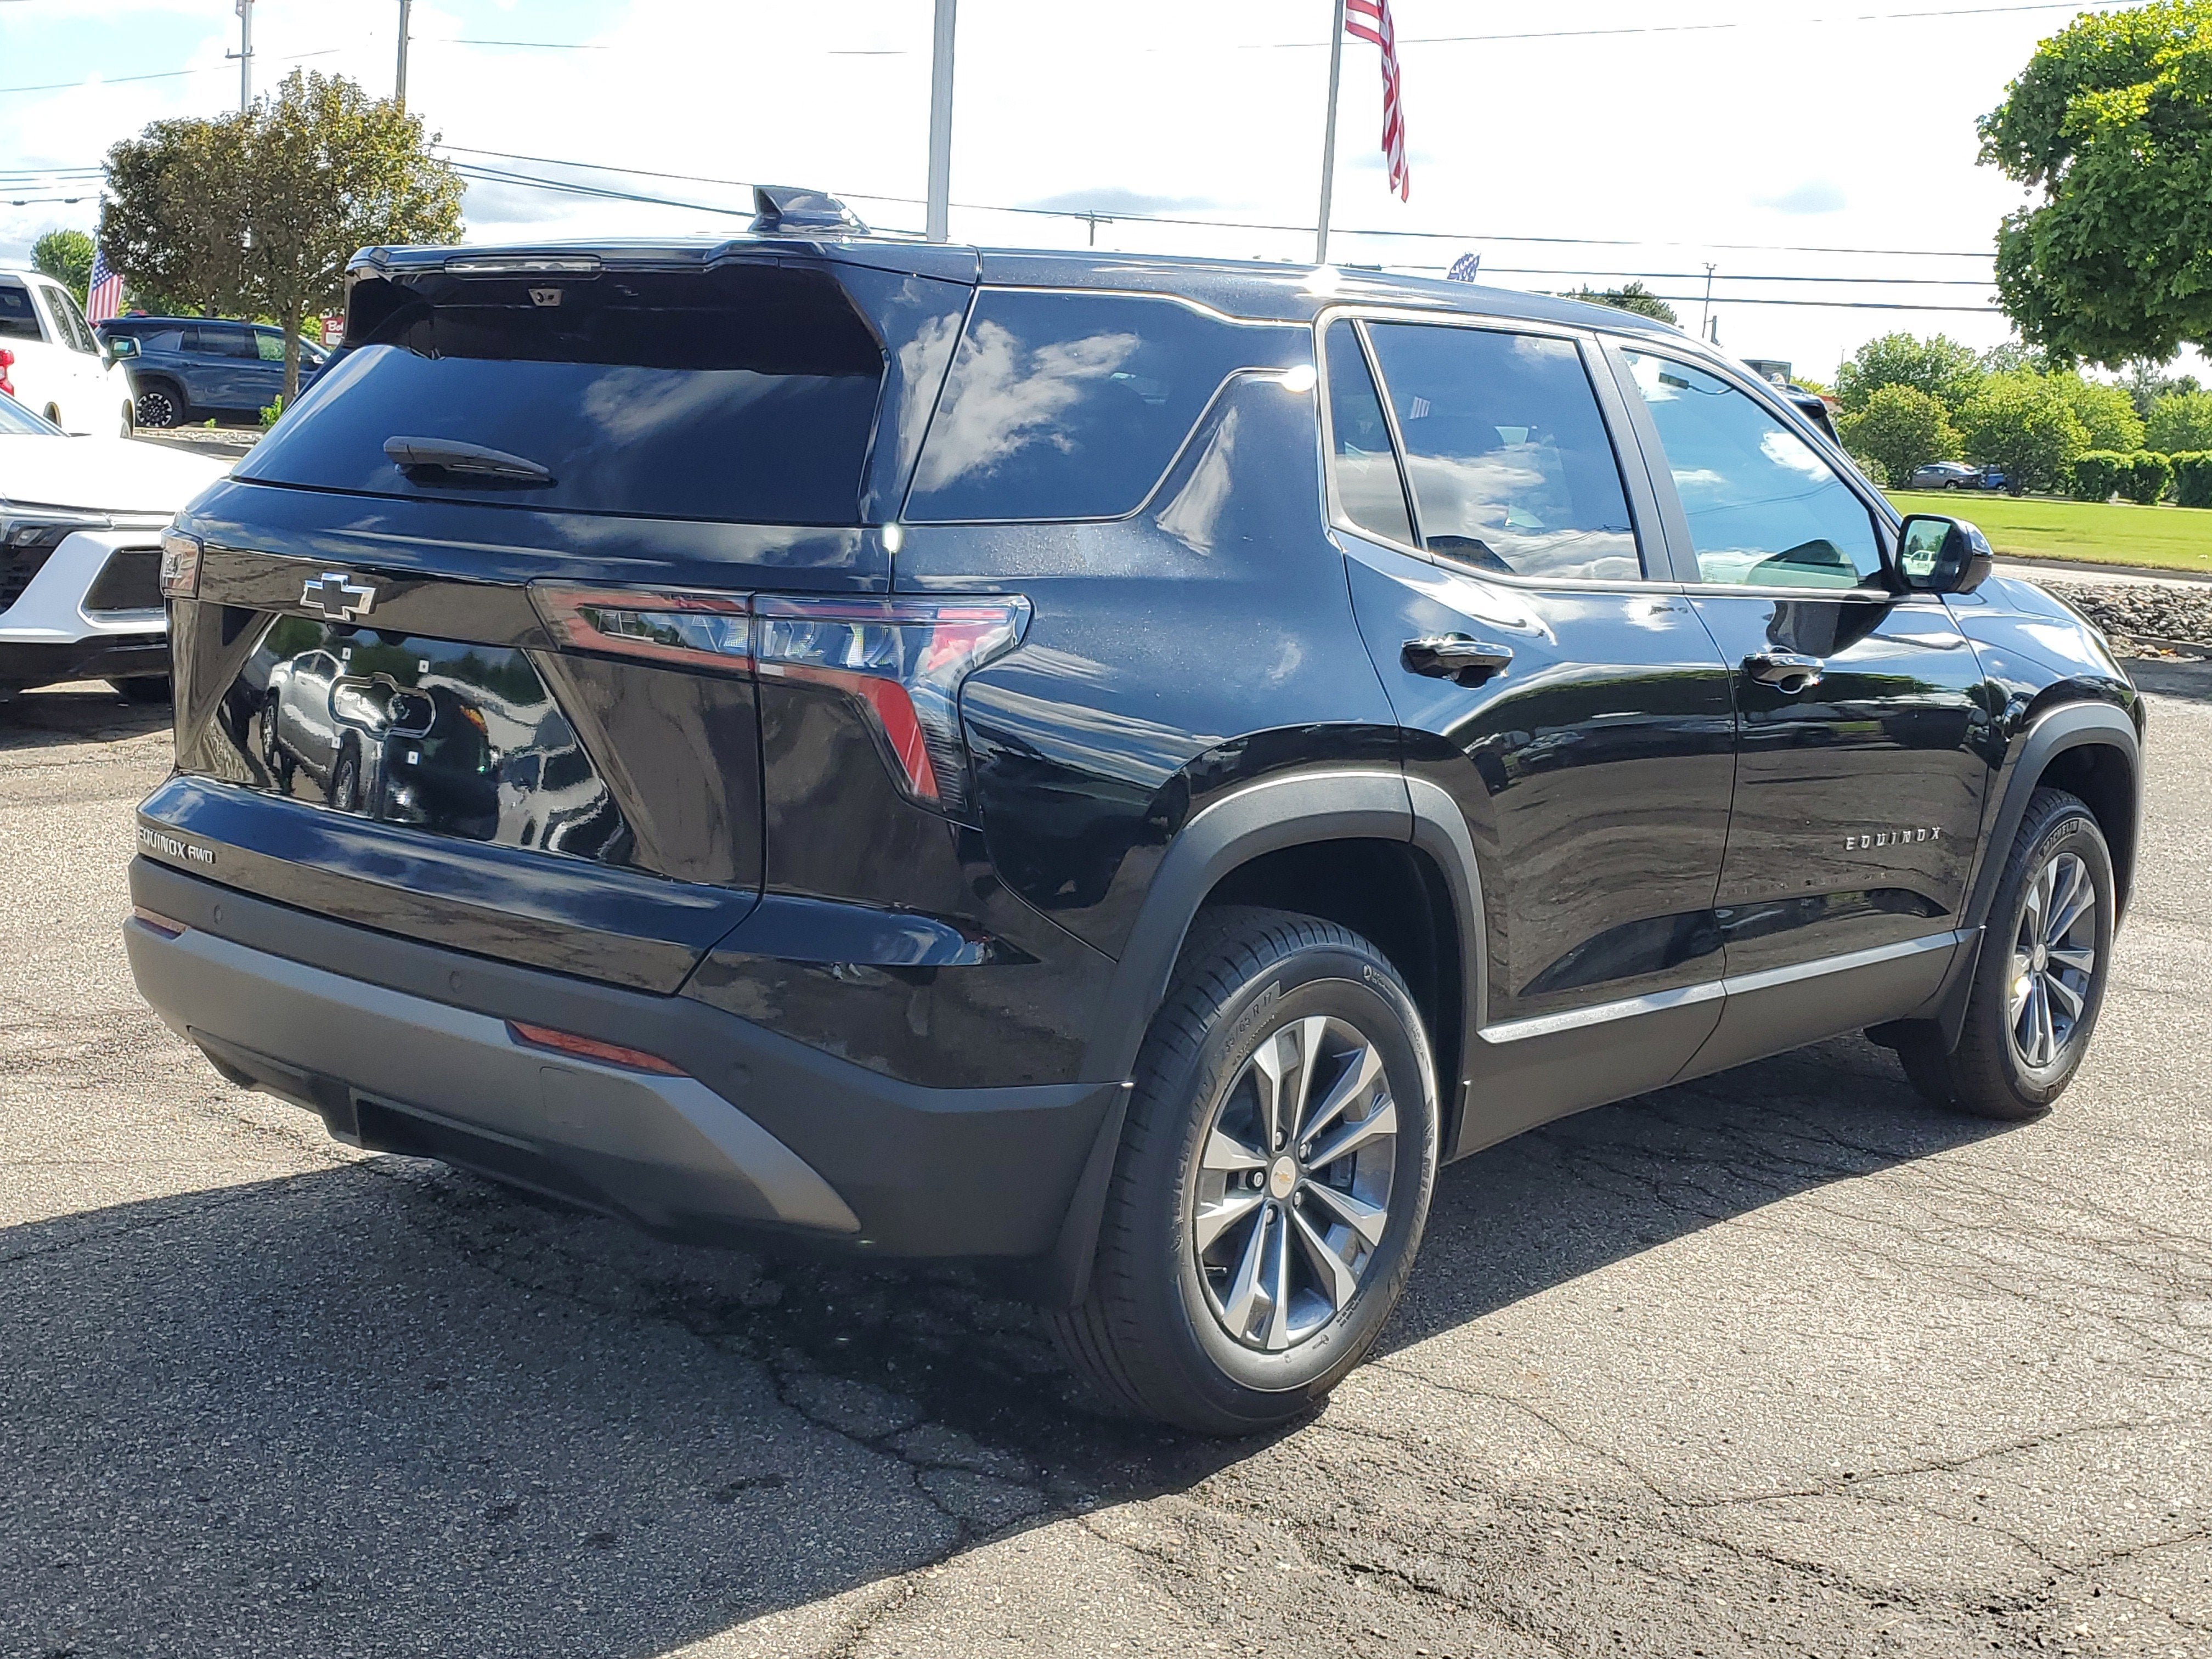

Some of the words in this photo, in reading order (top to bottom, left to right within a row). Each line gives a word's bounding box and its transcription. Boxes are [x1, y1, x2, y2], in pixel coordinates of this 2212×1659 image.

[139, 826, 187, 860] EQUINOX
[188, 845, 214, 864] AWD
[1846, 826, 1942, 850] EQUINOX
[2044, 821, 2078, 856] MICHELIN
